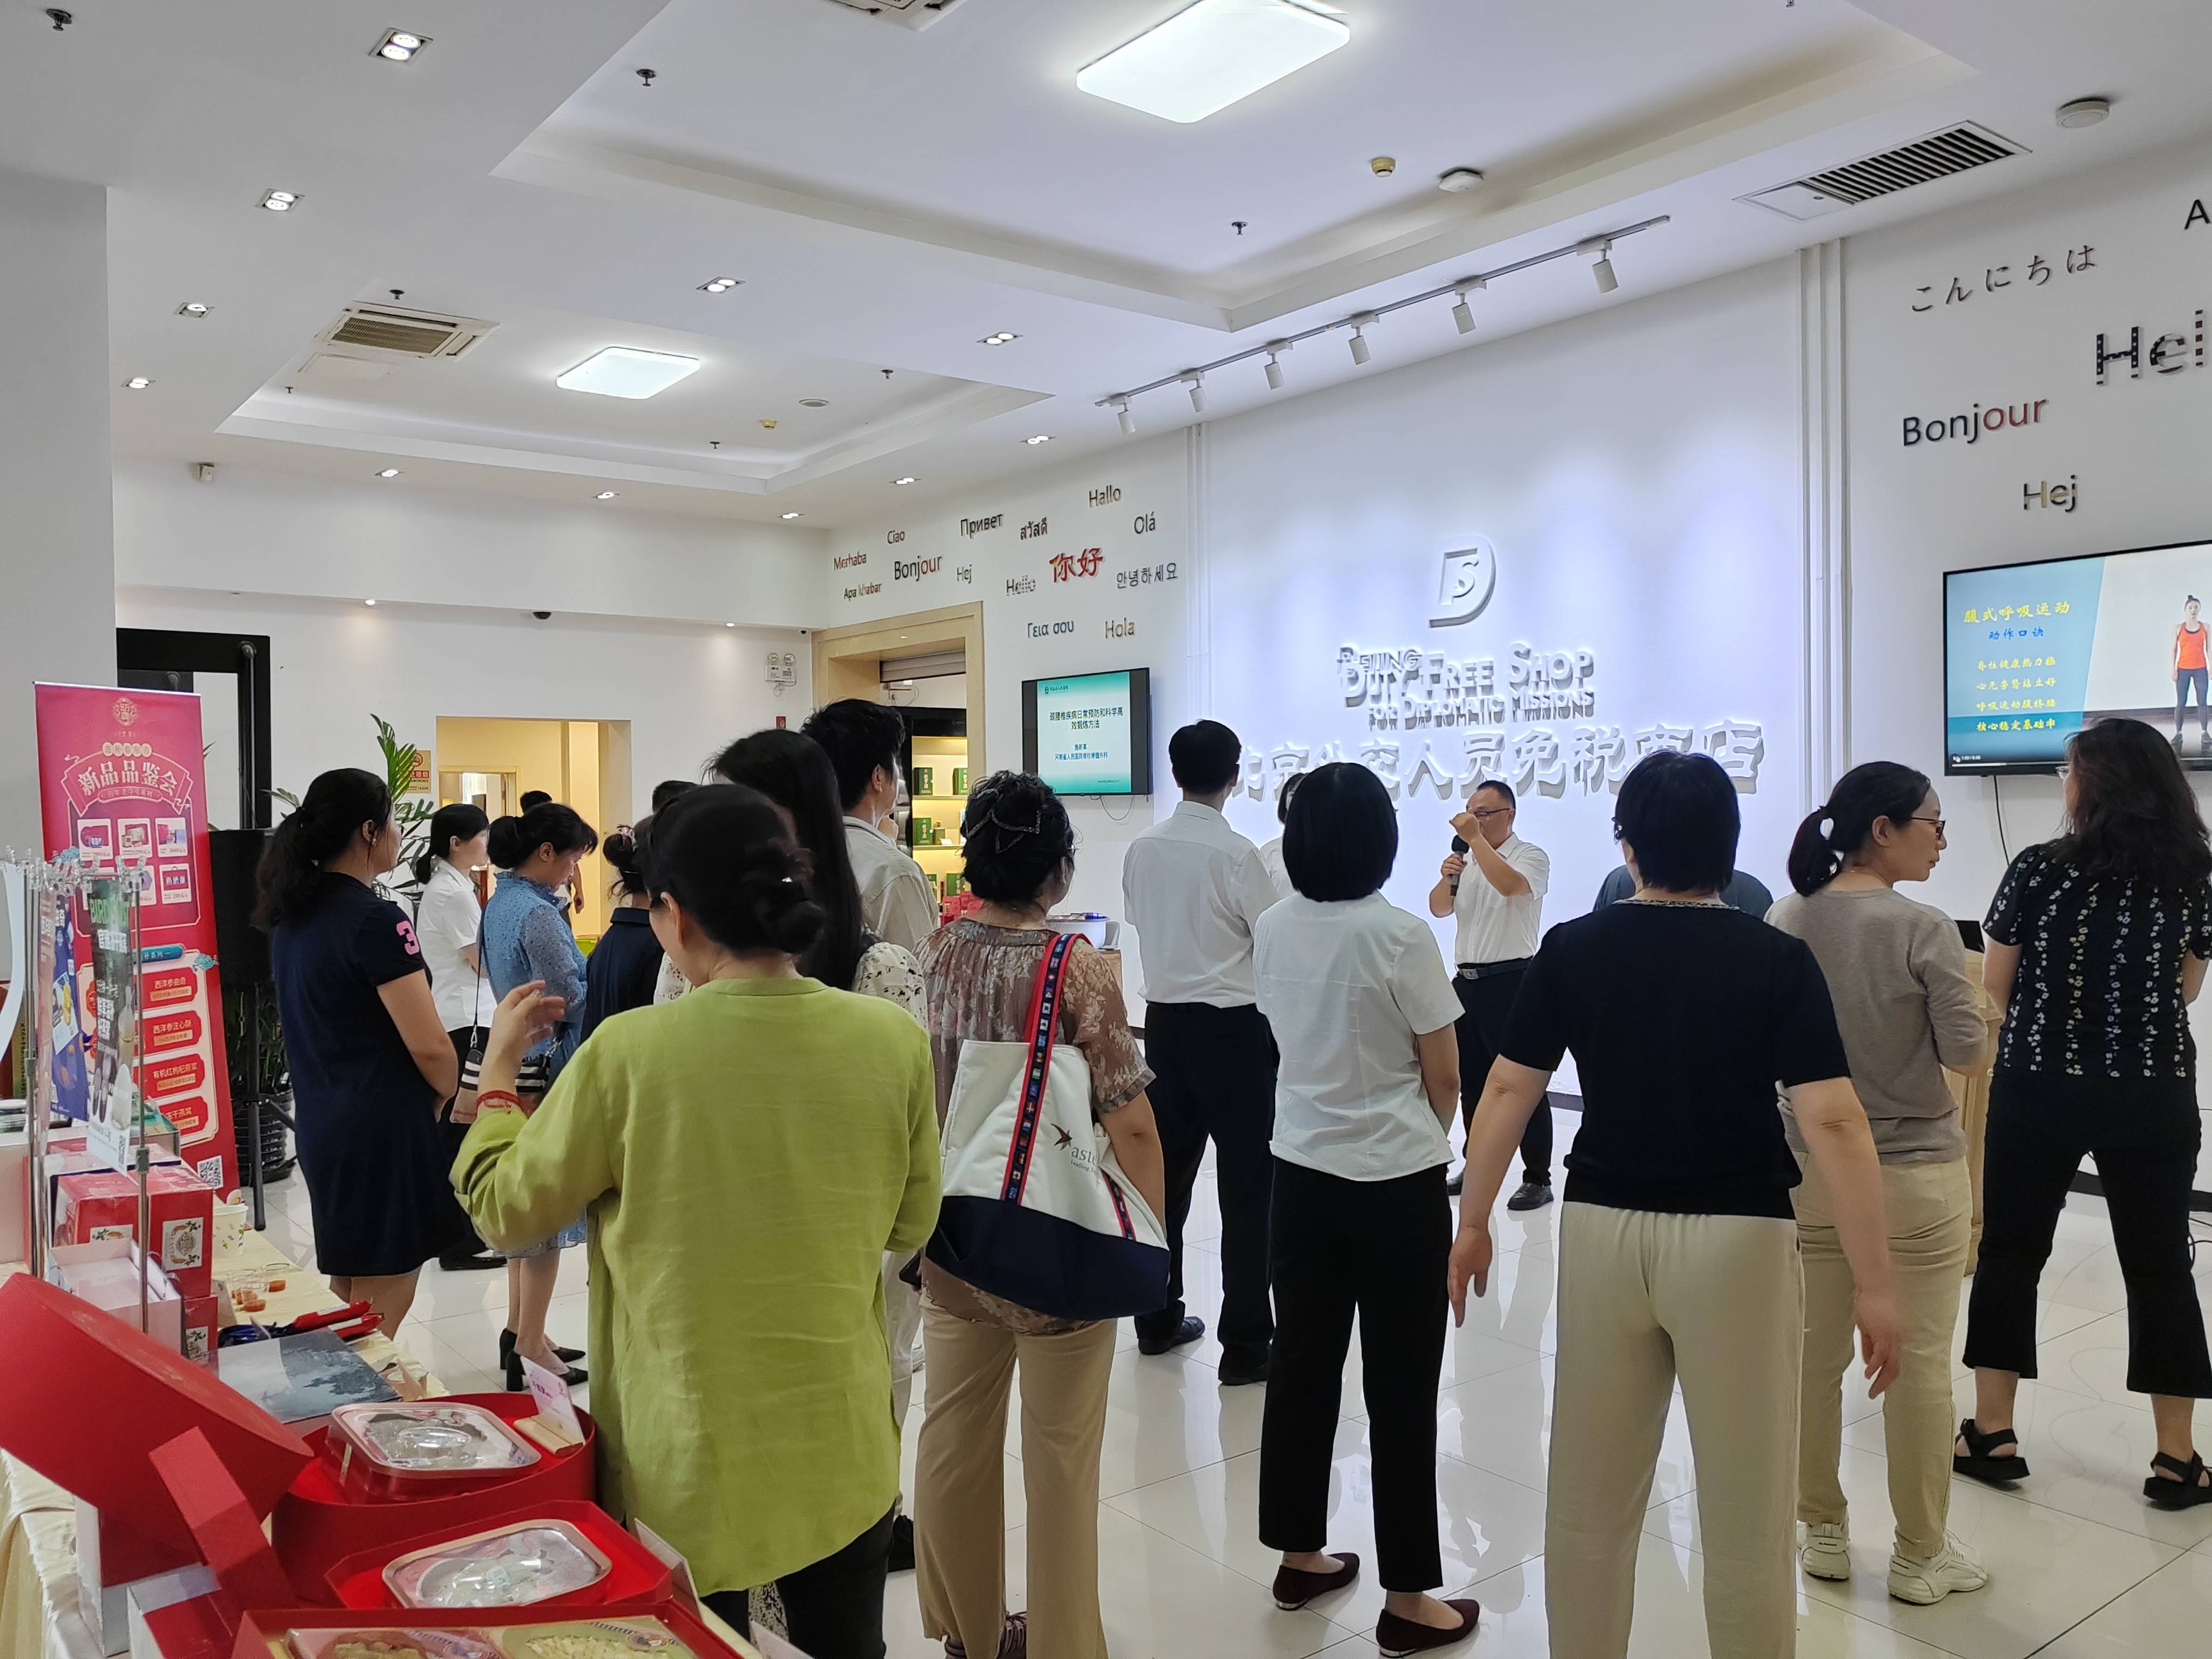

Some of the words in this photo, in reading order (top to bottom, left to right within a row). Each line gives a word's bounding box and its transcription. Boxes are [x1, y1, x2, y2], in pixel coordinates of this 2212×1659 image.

[1912, 245, 2096, 312] こんにちは
[1903, 399, 2048, 447] Bonjour
[1088, 484, 1121, 508] Hallo
[2023, 474, 2078, 512] Hej
[960, 514, 1003, 539] Привет
[1020, 516, 1048, 540] สวัสดี
[1134, 511, 1156, 534] Olá
[887, 529, 905, 544] Ciao
[833, 551, 867, 571] Merhaba
[894, 555, 942, 582] Bonjour
[1049, 547, 1105, 583] 你好
[956, 564, 972, 584] Hej
[1006, 575, 1036, 596] Hello
[1116, 562, 1178, 589] 안녕하세요
[844, 588, 857, 601] Apa
[1963, 601, 2071, 624] 腹式呼吸运动
[1027, 622, 1049, 639] Γεια
[1053, 620, 1075, 635] σου
[1105, 617, 1135, 639] Hola
[1988, 626, 2045, 640] 动作口诀
[1336, 645, 1422, 675] BEIJING
[1421, 653, 1494, 698] FREE
[1508, 643, 1594, 691] SHOP
[1404, 696, 1506, 727] DIPLOMATIC
[1510, 687, 1595, 719] MISSIONS
[1071, 720, 1101, 730] 效锻炼方法
[77, 760, 178, 797] 新品品鉴会
[396, 920, 420, 955] 3
